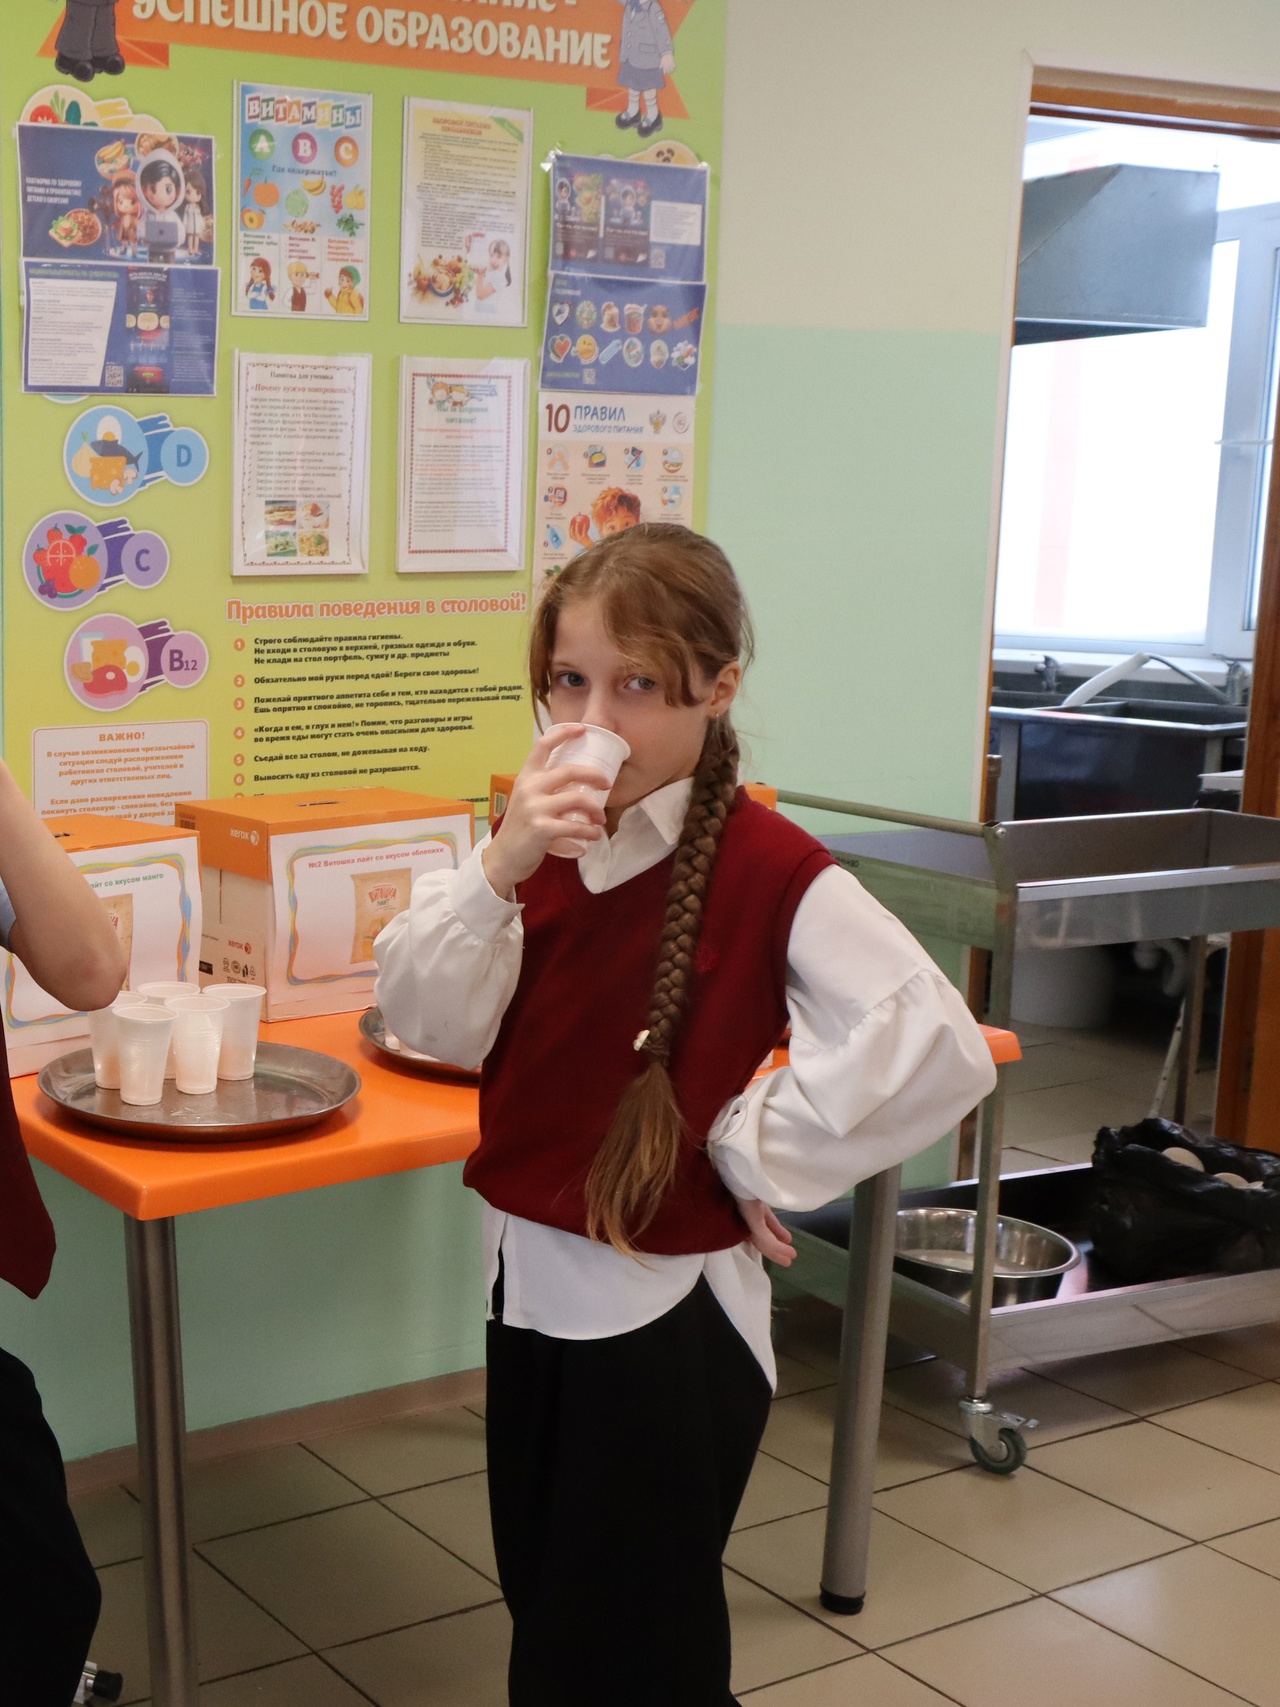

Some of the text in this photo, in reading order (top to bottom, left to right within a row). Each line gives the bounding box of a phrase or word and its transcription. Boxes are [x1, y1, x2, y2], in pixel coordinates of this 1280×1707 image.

[357, 8, 611, 68] ОБРАЗОВАНИЕ
[248, 96, 362, 129] ВИТАМИНЫ
[546, 403, 570, 433] 10
[574, 405, 626, 421] ПРАВИЛ
[227, 591, 527, 625] Правила поведения в столовой!
[254, 637, 282, 646] Строго
[283, 634, 332, 644] соблюдайте
[345, 643, 379, 651] верхней,
[453, 640, 477, 648] обуви.
[324, 654, 364, 663] портфель,
[411, 650, 450, 659] предметы
[254, 676, 307, 684] Обязательно
[309, 674, 324, 682] мой
[325, 674, 344, 682] руки
[346, 673, 370, 681] перед
[372, 671, 393, 680] едой!
[394, 670, 420, 678] Береги
[442, 667, 479, 676] здоровье!
[99, 732, 145, 742] ВАЖНО!
[254, 754, 283, 763] Съедай
[310, 751, 340, 760] столом,
[410, 745, 430, 753] ходу.
[254, 773, 294, 782] Выносить
[296, 772, 309, 780] еду
[321, 768, 358, 776] столовой
[370, 765, 420, 774] разрешается.
[230, 828, 249, 840] xerox
[324, 857, 355, 867] Витошка
[357, 855, 373, 863] лайт
[385, 851, 410, 860] вкусом
[412, 847, 444, 856] облепихи
[115, 877, 140, 885] вкусом
